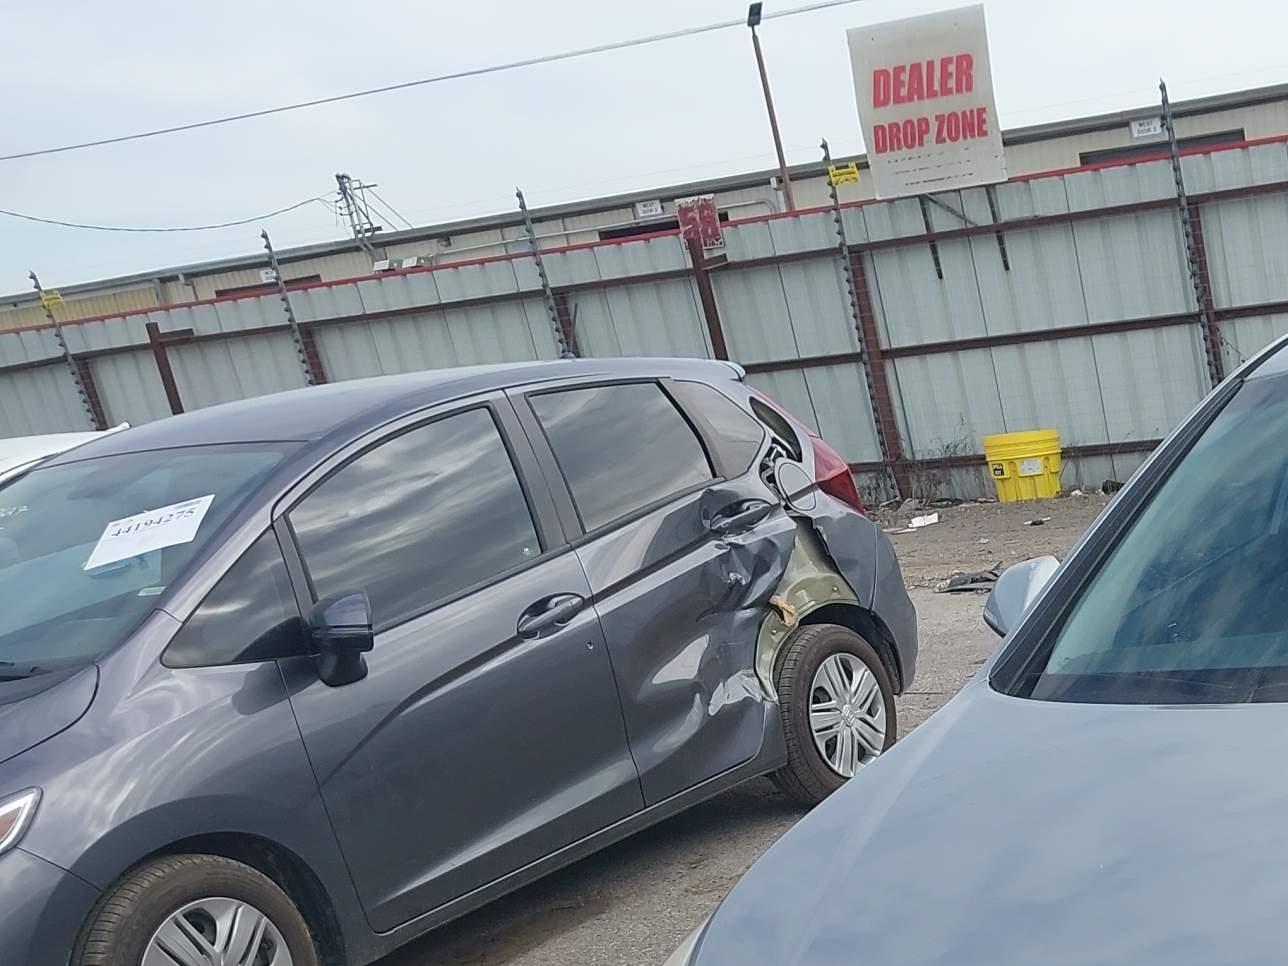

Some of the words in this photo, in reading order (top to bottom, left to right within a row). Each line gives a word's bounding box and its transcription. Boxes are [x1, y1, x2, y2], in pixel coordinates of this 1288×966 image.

[873, 54, 973, 108] DEALER
[873, 117, 930, 154] DROP
[935, 107, 988, 144] ZONE
